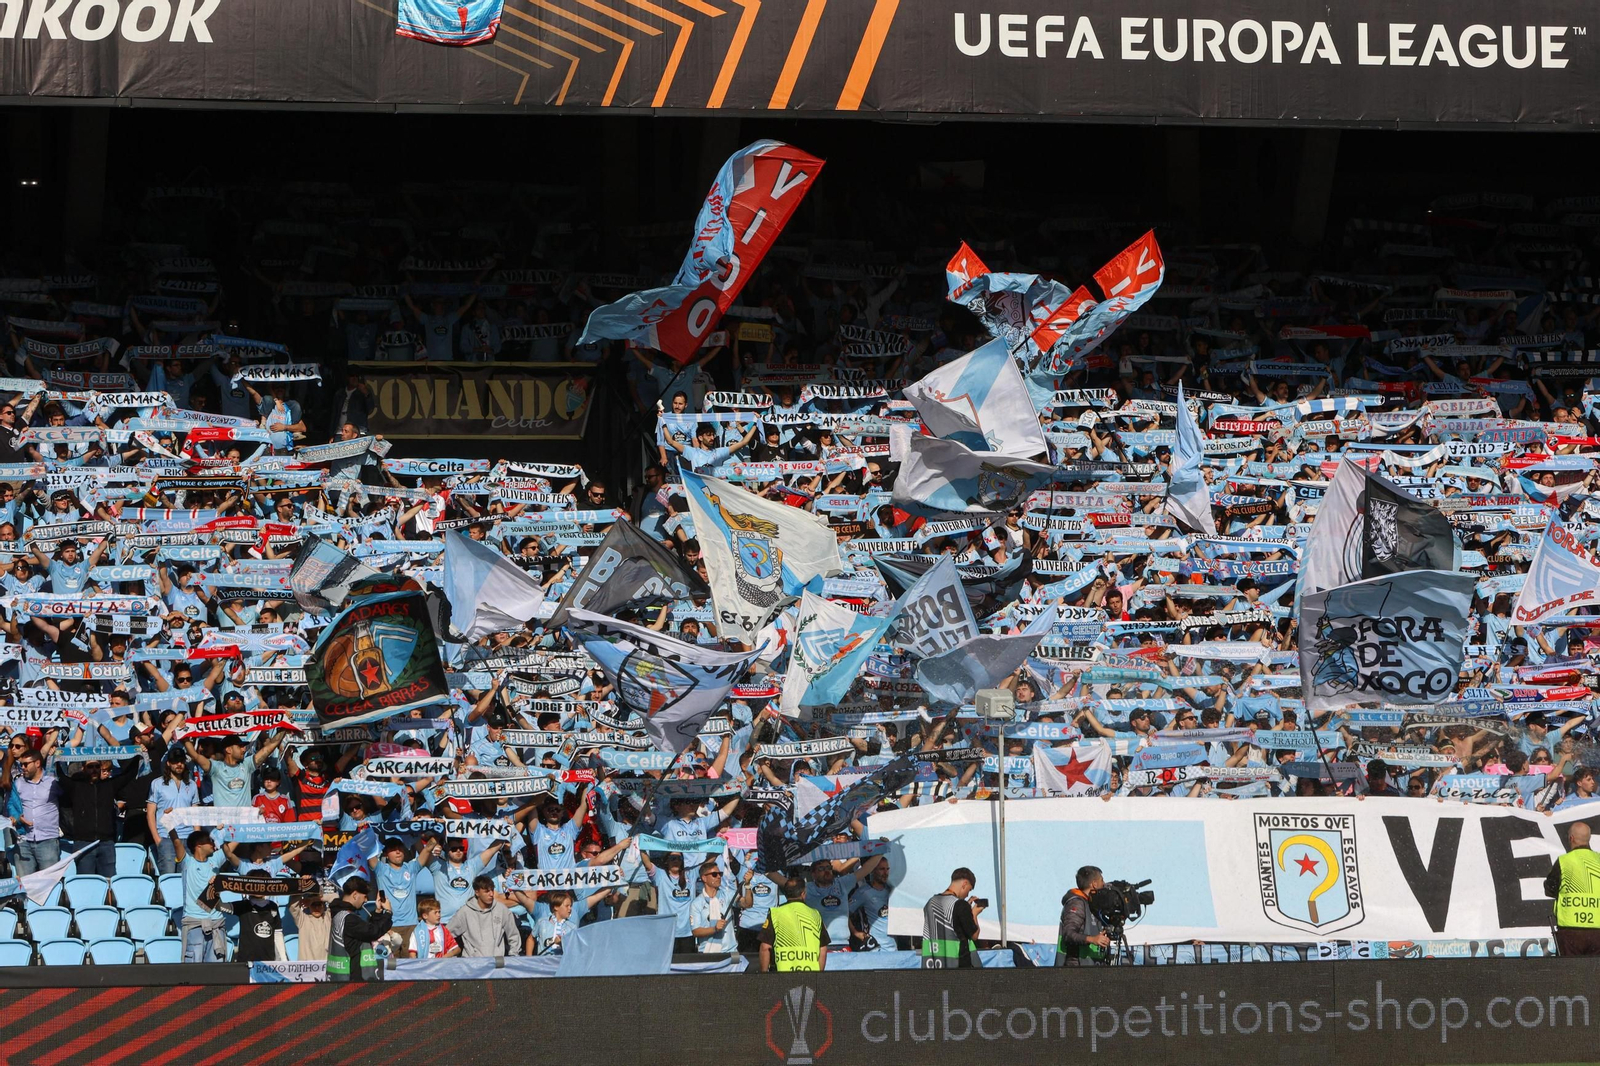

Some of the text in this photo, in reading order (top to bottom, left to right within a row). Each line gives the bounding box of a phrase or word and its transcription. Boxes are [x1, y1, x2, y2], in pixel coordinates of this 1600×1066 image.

[954, 13, 1104, 59] UEFA
[1120, 17, 1341, 65] EUROPA
[1358, 22, 1569, 69] LEAGUE
[28, 341, 101, 355] EURO CELTA
[137, 345, 213, 354] EURO CELTA
[50, 371, 126, 385] EURO CELTA
[491, 415, 553, 429] Celta
[1302, 419, 1362, 432] EURO CEL
[742, 467, 776, 476] ASPAS
[500, 488, 570, 504] OLIVEIRA DE TEIS
[1055, 495, 1105, 507] CELTA
[554, 510, 598, 522] CELTA
[1097, 515, 1162, 524] UNITED CELTA
[1513, 514, 1549, 524] CELTA
[34, 523, 75, 539] FUTBOL
[931, 521, 966, 534] OLIVEIRA
[1057, 520, 1066, 529] DE
[1067, 519, 1083, 530] TEIS
[858, 541, 906, 552] OLIVEIRA DE
[1036, 560, 1074, 571] OLIVEIRA
[1257, 562, 1289, 573] CELTA
[51, 602, 120, 614] GALIZA
[1516, 598, 1565, 622] CELTA
[1358, 617, 1445, 644] FORA
[1357, 641, 1403, 668] DE
[1358, 667, 1452, 700] XOGO
[379, 676, 431, 707] BIRRAS
[530, 701, 563, 712] JORGE
[235, 715, 251, 729] DE
[252, 712, 285, 728] VIGO
[509, 733, 550, 745] FUTBOL
[71, 746, 128, 756] R.C. CELTA
[449, 781, 490, 795] FUTBOL
[505, 778, 548, 793] BIRRAS
[1451, 778, 1500, 789] AFOUTE
[267, 824, 317, 832] RECONQUISTA
[446, 820, 511, 837] CAMÄNS
[1258, 816, 1350, 829] MORTOS QVE
[527, 868, 620, 887] CARCAMÄNS
[1259, 841, 1276, 907] DENANTES
[1342, 837, 1360, 910] ESCRAVOS
[1382, 815, 1600, 932] VE
[222, 880, 289, 893] REAL CLUB CELTA
[1561, 897, 1600, 908] SECURIT
[1574, 912, 1595, 923] 192
[256, 964, 286, 974] BAIXO
[288, 963, 320, 973] MINHO
[860, 980, 1590, 1052] clubcompetitions-shop.com
